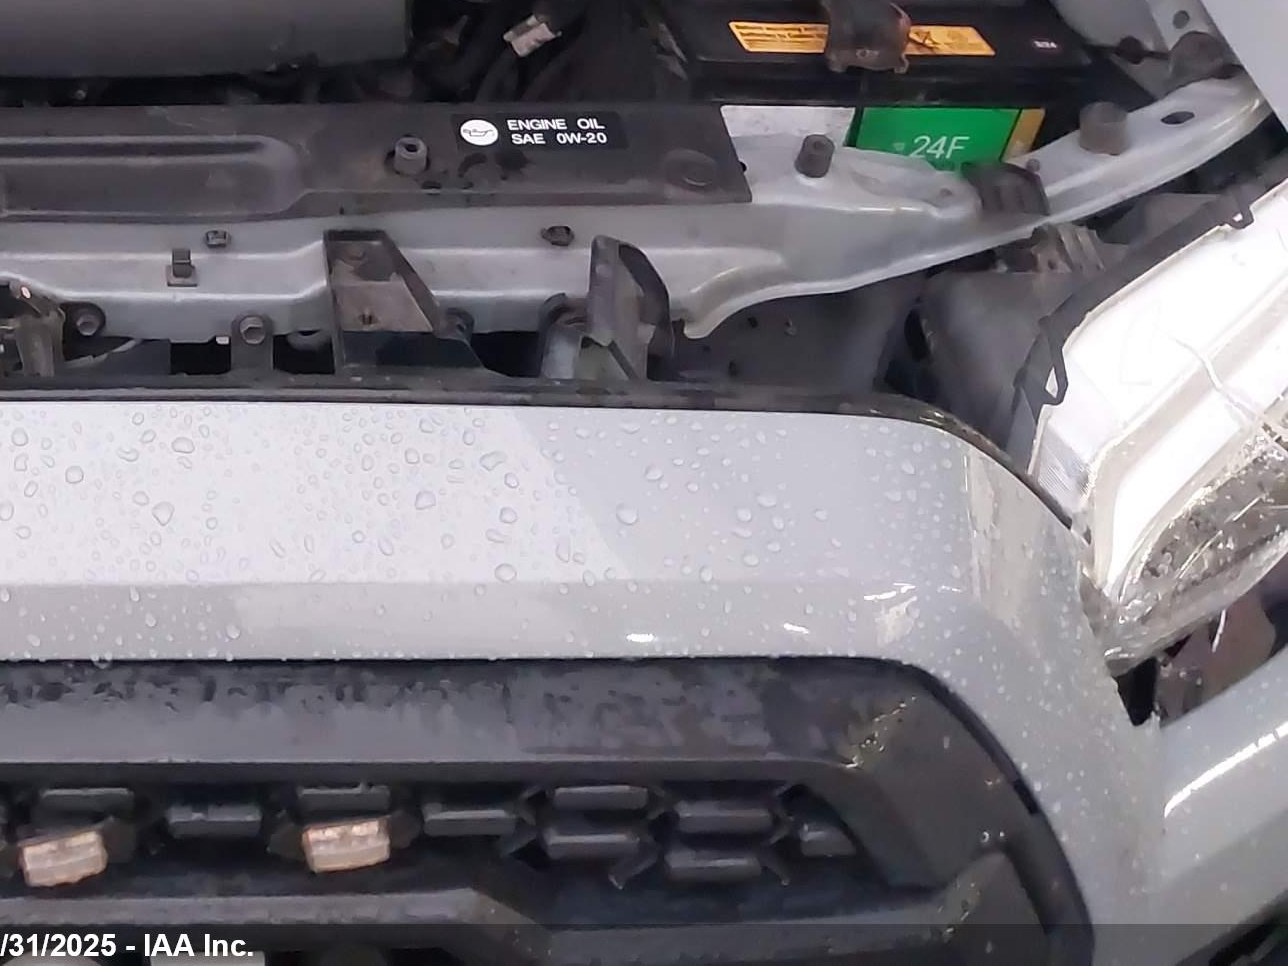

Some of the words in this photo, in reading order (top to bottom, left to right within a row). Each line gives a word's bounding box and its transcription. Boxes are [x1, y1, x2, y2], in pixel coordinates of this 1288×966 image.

[506, 118, 568, 131] ENGINE
[576, 118, 606, 130] OIL
[511, 132, 546, 145] SAE
[556, 132, 608, 144] 0W-20
[909, 135, 970, 159] 24F
